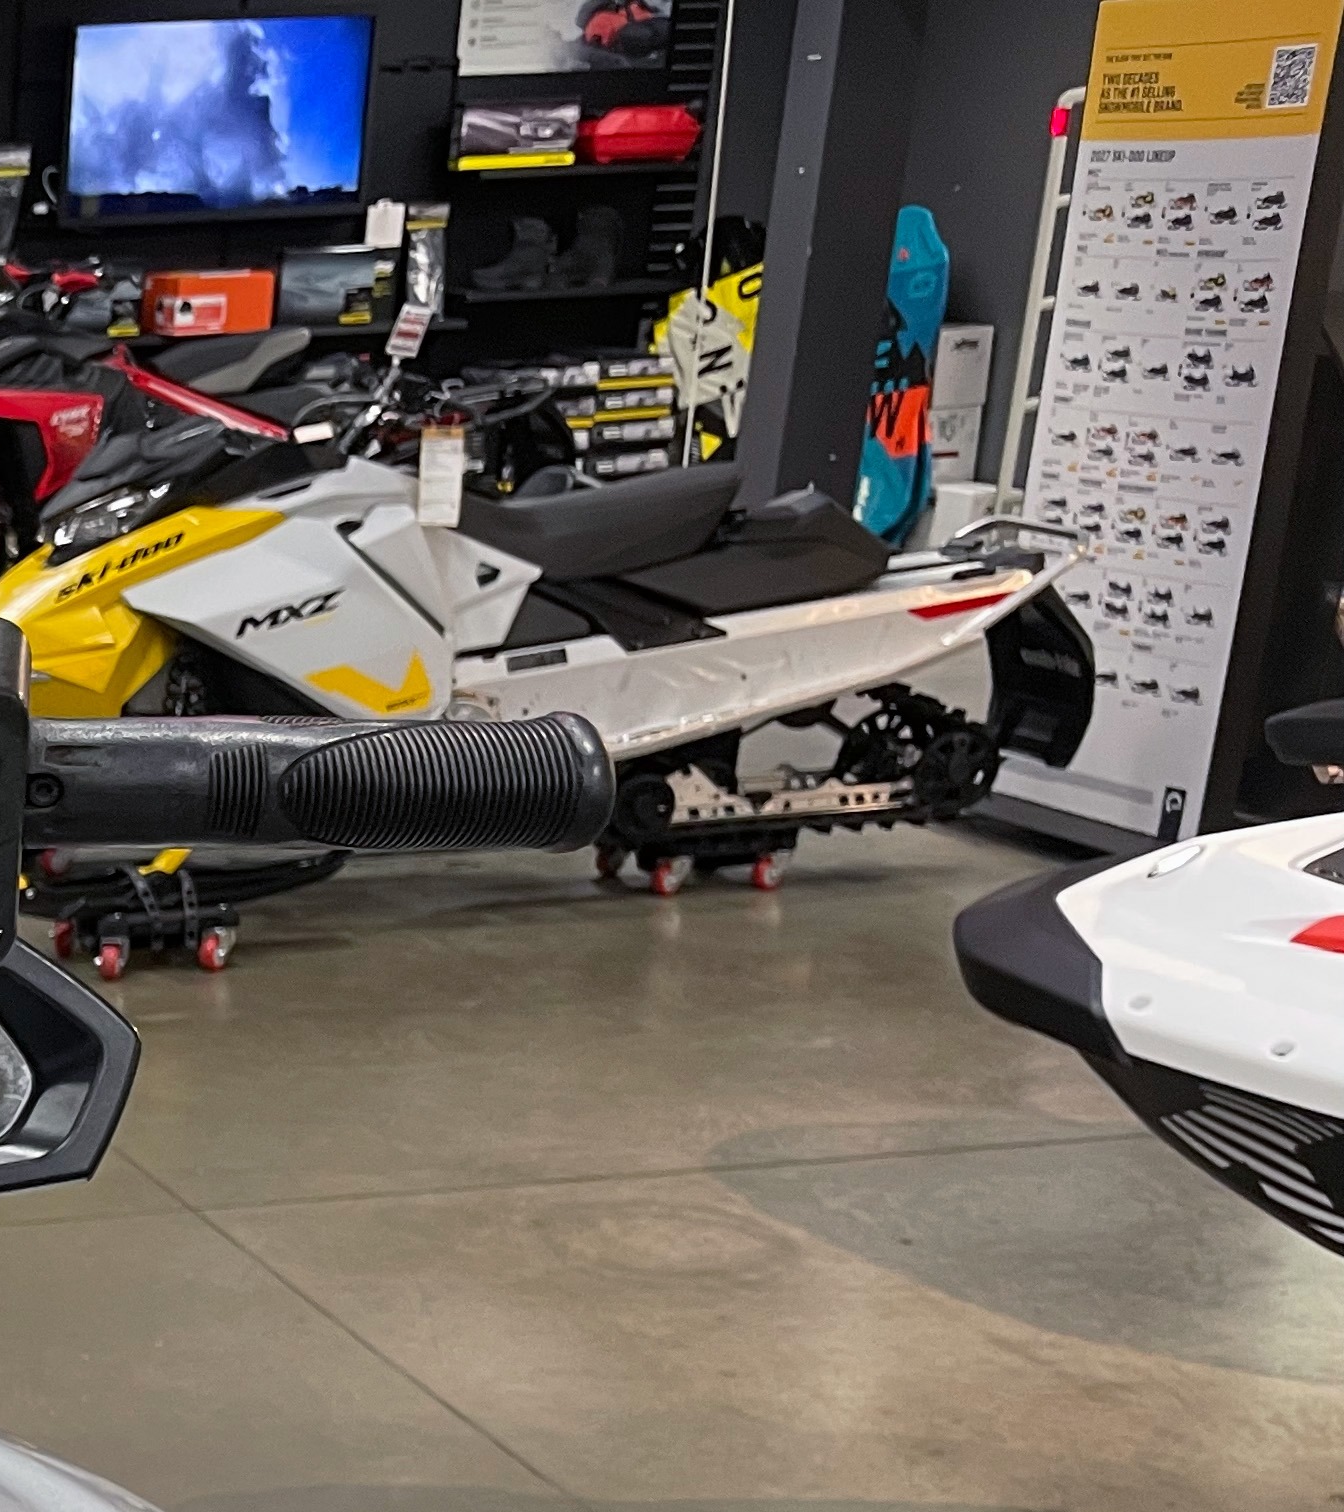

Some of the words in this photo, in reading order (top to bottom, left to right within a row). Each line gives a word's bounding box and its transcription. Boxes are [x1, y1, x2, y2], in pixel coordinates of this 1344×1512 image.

[1100, 87, 1111, 99] AS
[1113, 87, 1128, 99] THE
[1142, 86, 1176, 98] SELLING
